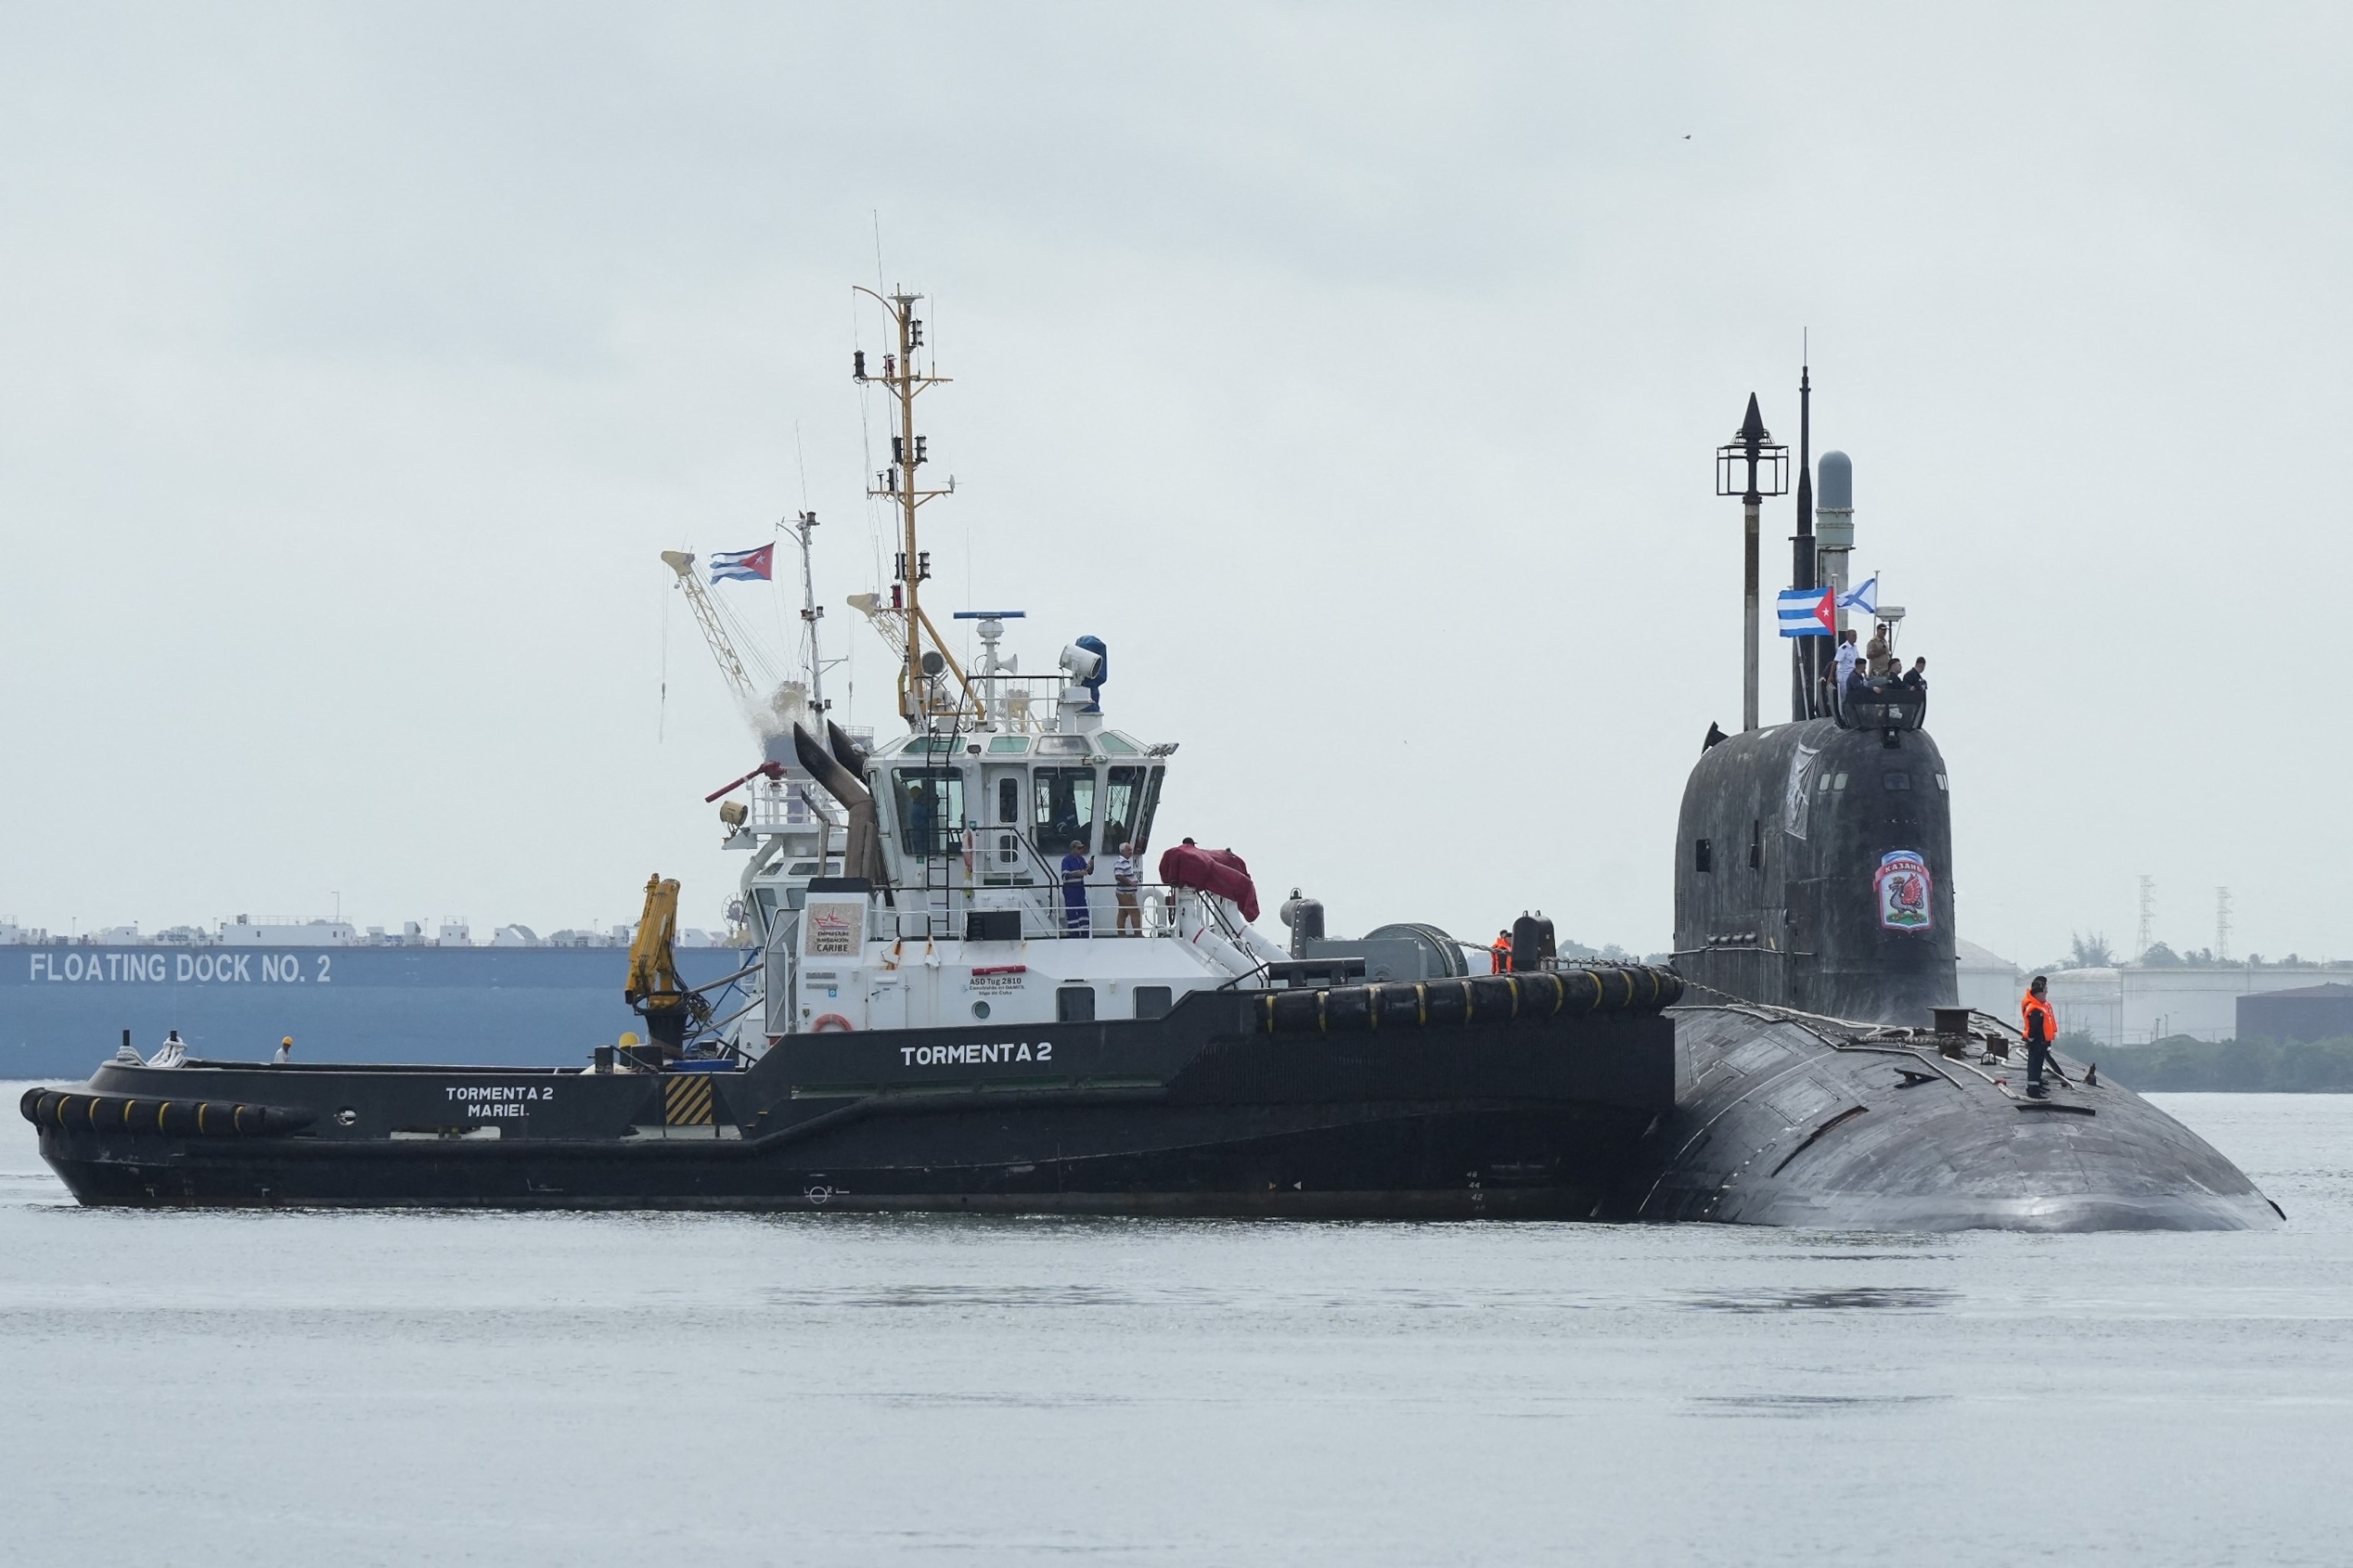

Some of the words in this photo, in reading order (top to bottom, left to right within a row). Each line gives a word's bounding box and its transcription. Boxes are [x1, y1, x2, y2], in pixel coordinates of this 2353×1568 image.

[1884, 863, 1922, 873] КАЗАНЬ
[817, 944, 848, 952] CARIBE
[30, 953, 166, 982] FLOATING
[176, 954, 251, 982] DOCK
[262, 954, 306, 983] NO.
[316, 954, 331, 982] 2
[900, 1043, 1033, 1066] TORMENTA
[1036, 1042, 1052, 1061] 2
[446, 1087, 538, 1101] TORMENTA
[542, 1087, 554, 1100] 2
[826, 1185, 833, 1194] R
